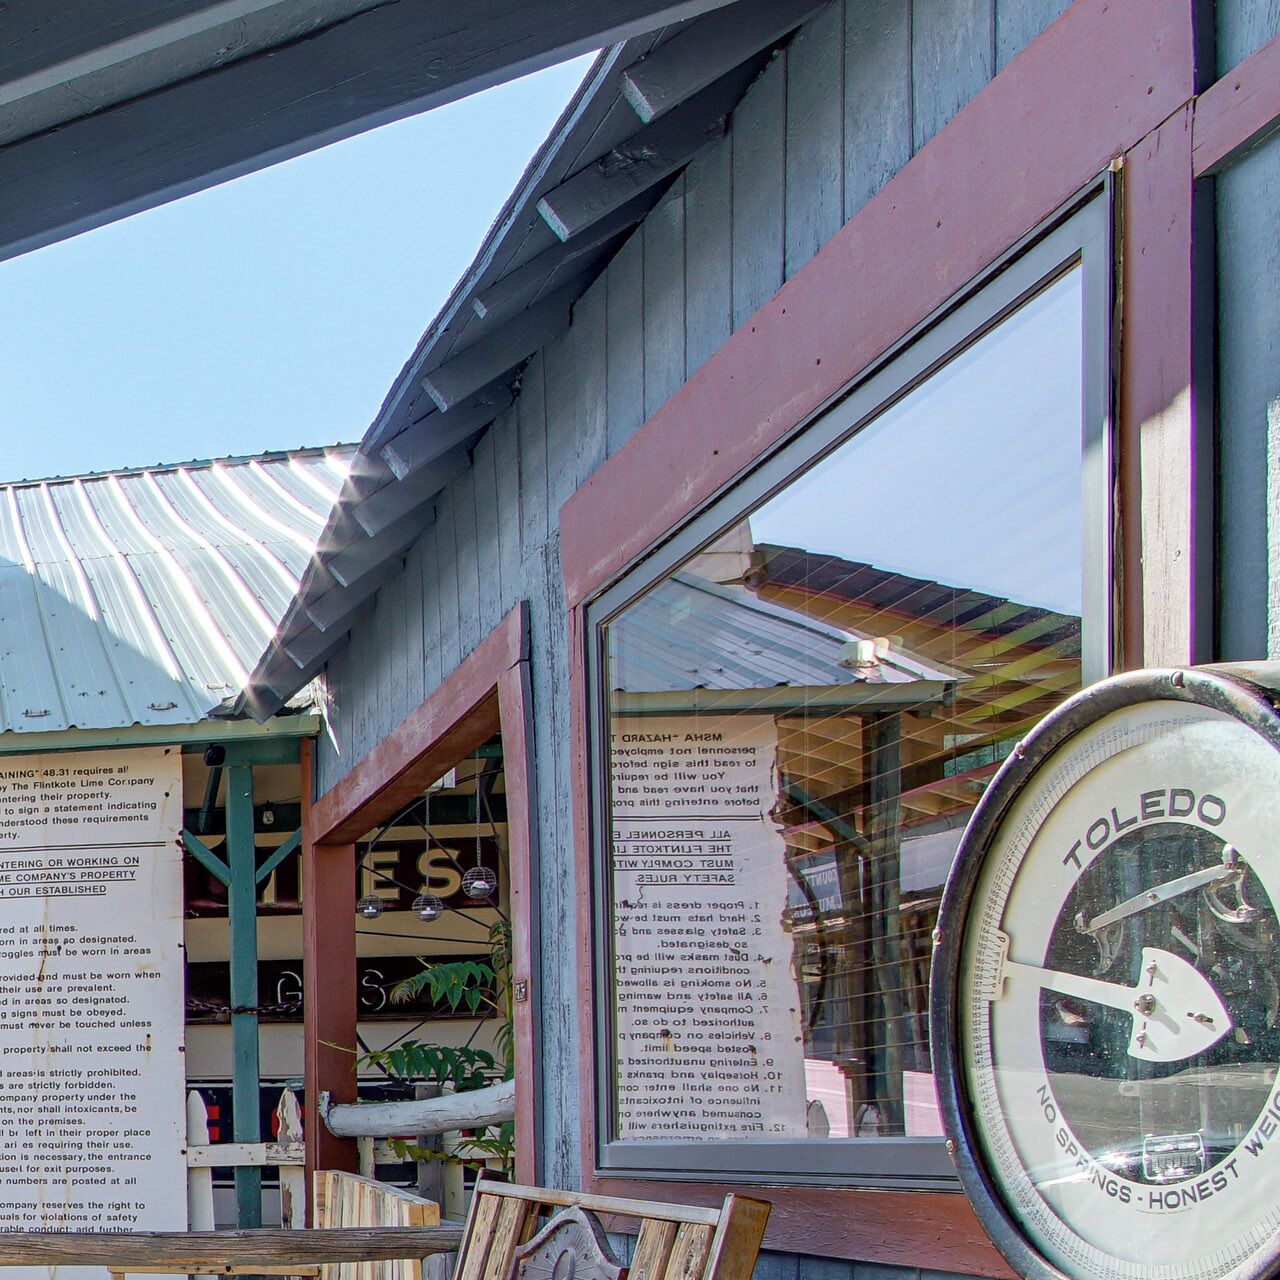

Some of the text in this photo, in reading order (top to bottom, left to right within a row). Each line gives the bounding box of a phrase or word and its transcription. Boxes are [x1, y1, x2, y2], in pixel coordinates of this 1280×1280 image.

[43, 769, 69, 778] 48.31
[73, 764, 114, 778] requires
[11, 782, 29, 792] The
[33, 779, 76, 791] Flintkote
[80, 778, 104, 788] Lime
[40, 792, 63, 802] their
[67, 790, 112, 803] property.
[4, 806, 15, 815] to
[18, 805, 40, 817] sign
[54, 802, 103, 813] statement
[107, 799, 157, 813] indicating
[52, 815, 79, 825] these
[82, 812, 149, 826] requirements
[1062, 788, 1226, 869] TOLEDO
[48, 859, 63, 868] OR
[66, 857, 118, 867] WORKING
[124, 856, 140, 865] ON
[16, 872, 77, 882] COMPANY'S
[80, 870, 136, 880] PROPERTY
[8, 888, 32, 896] OUR
[36, 885, 107, 895] ESTABLISHED
[0, 985, 22, 994] their
[67, 983, 116, 995] prevalent.
[277, 970, 386, 1010] GS
[12, 997, 21, 1005] in
[72, 995, 130, 1006] designated.
[11, 1009, 38, 1020] signs
[42, 1008, 66, 1017] must
[69, 1008, 82, 1016] be
[86, 1007, 126, 1018] obeyed.
[28, 1081, 61, 1091] strictly
[64, 1080, 116, 1089] forbidden.
[18, 1117, 34, 1125] the
[38, 1117, 86, 1127] premises.
[1036, 1085, 1057, 1124] NO
[1149, 1158, 1240, 1210] HONEST
[6, 1176, 48, 1184] numbers
[72, 1176, 106, 1187] posted
[110, 1176, 120, 1184] at
[124, 1176, 137, 1184] all
